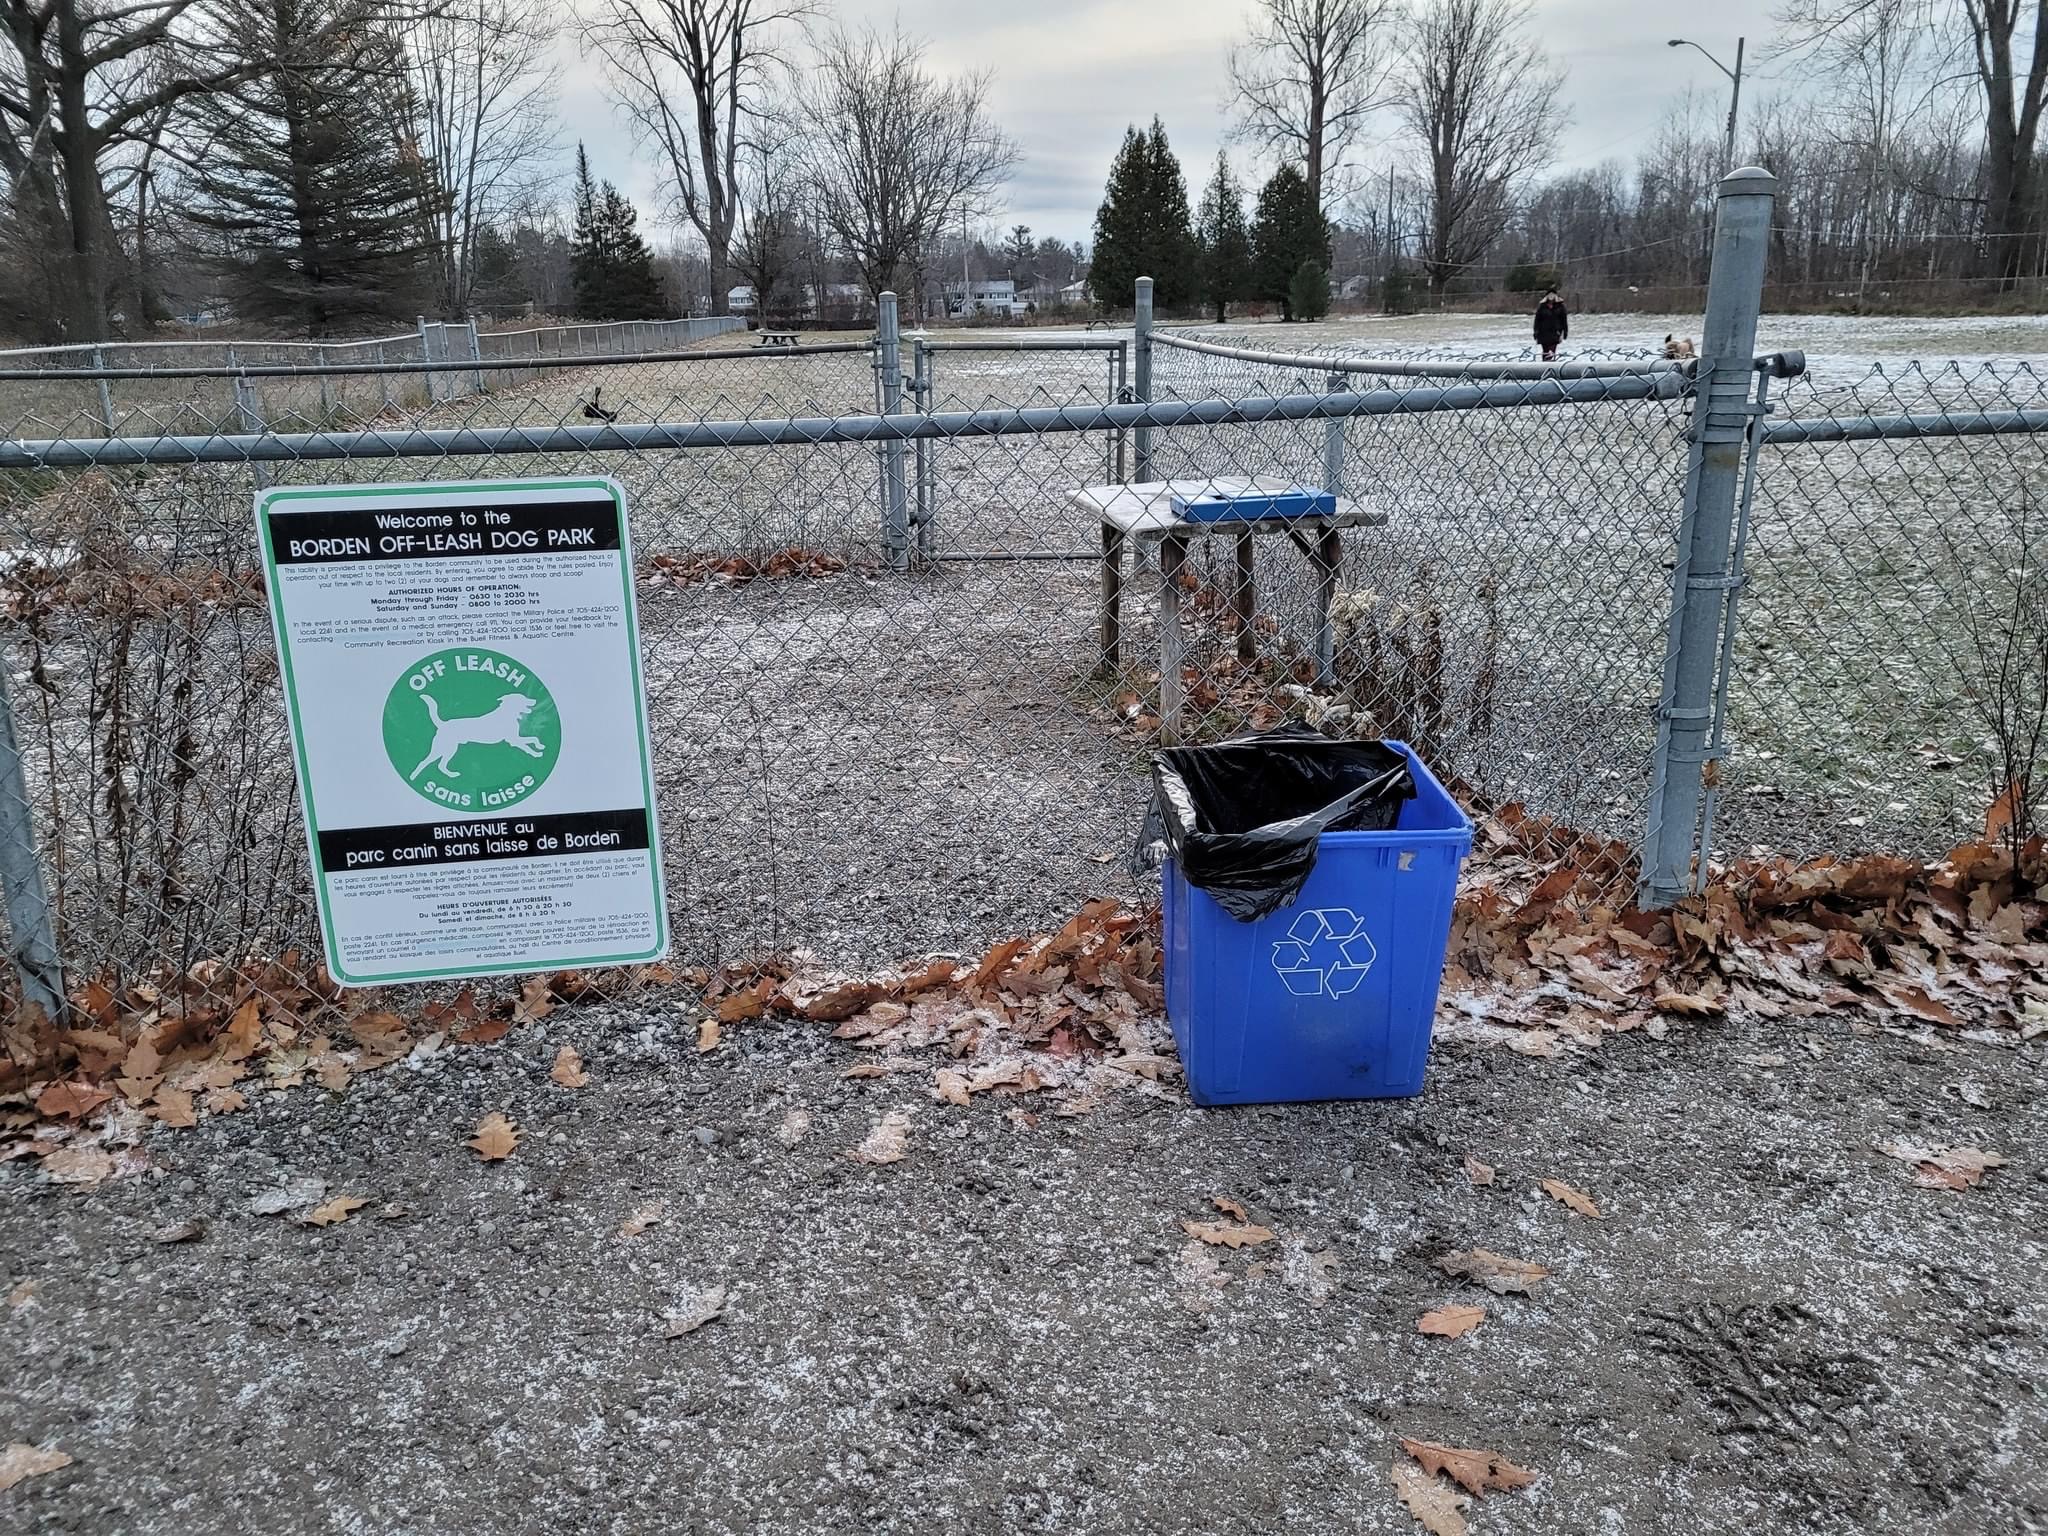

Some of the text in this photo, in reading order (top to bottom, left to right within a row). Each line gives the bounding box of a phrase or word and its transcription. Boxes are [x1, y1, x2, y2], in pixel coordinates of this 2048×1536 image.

[375, 510, 510, 529] Welcome to the
[290, 527, 595, 557] BORDEN OFF-LEASH DOG PARK
[397, 577, 407, 585] (2)
[388, 587, 434, 595] AUTHORIZED
[404, 596, 434, 604] through
[504, 591, 525, 599] 2030
[376, 604, 409, 612] Saturday
[430, 602, 458, 610] Sunday
[468, 600, 491, 608] 0800
[503, 598, 527, 606] 2000
[400, 615, 416, 623] such
[523, 609, 545, 617] Military
[408, 622, 435, 630] medical
[436, 621, 473, 629] emergency
[500, 618, 513, 626] You
[529, 617, 553, 625] provide
[571, 614, 602, 622] feedback
[437, 629, 459, 637] calling
[510, 625, 527, 633] local
[296, 635, 334, 644] contacting
[343, 641, 384, 649] Community
[522, 632, 548, 640] Aquatic
[409, 654, 527, 691] OFF LEASH
[423, 775, 535, 807] sans laisse
[433, 822, 534, 840] BIENVENUE au
[346, 831, 620, 867] parc canin sans laisse de Borden
[462, 907, 495, 915] vendredi,
[438, 916, 463, 924] Samedi
